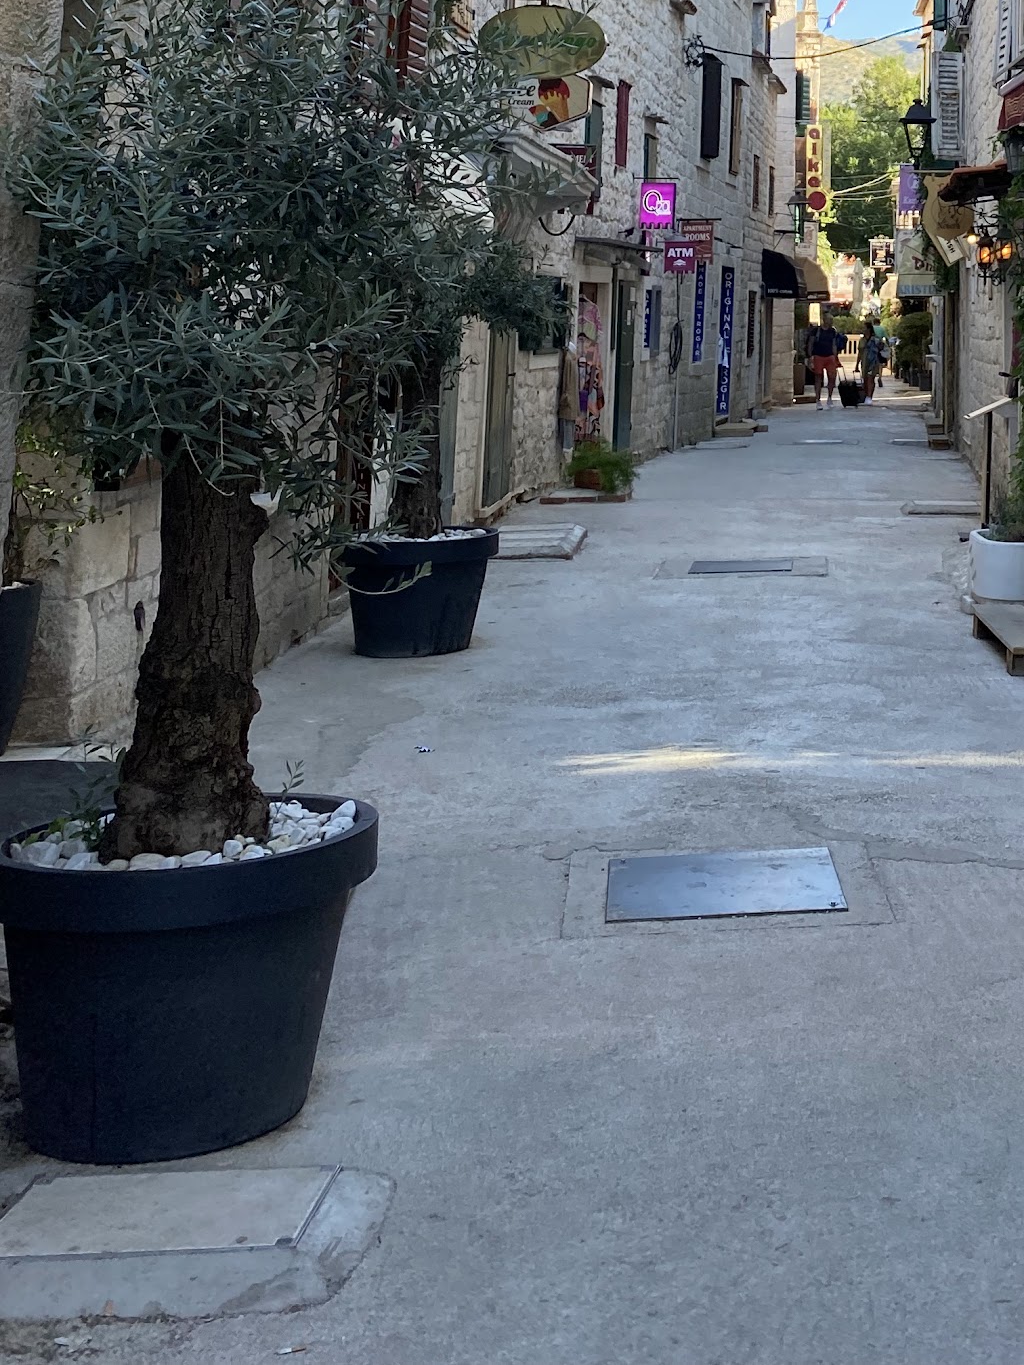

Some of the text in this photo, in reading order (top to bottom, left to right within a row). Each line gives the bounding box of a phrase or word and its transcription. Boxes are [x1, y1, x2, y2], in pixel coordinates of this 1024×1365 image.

[507, 97, 535, 106] Cream
[685, 233, 711, 241] ROOMS
[667, 247, 694, 258] ATM
[723, 272, 733, 339] ORIGINAL
